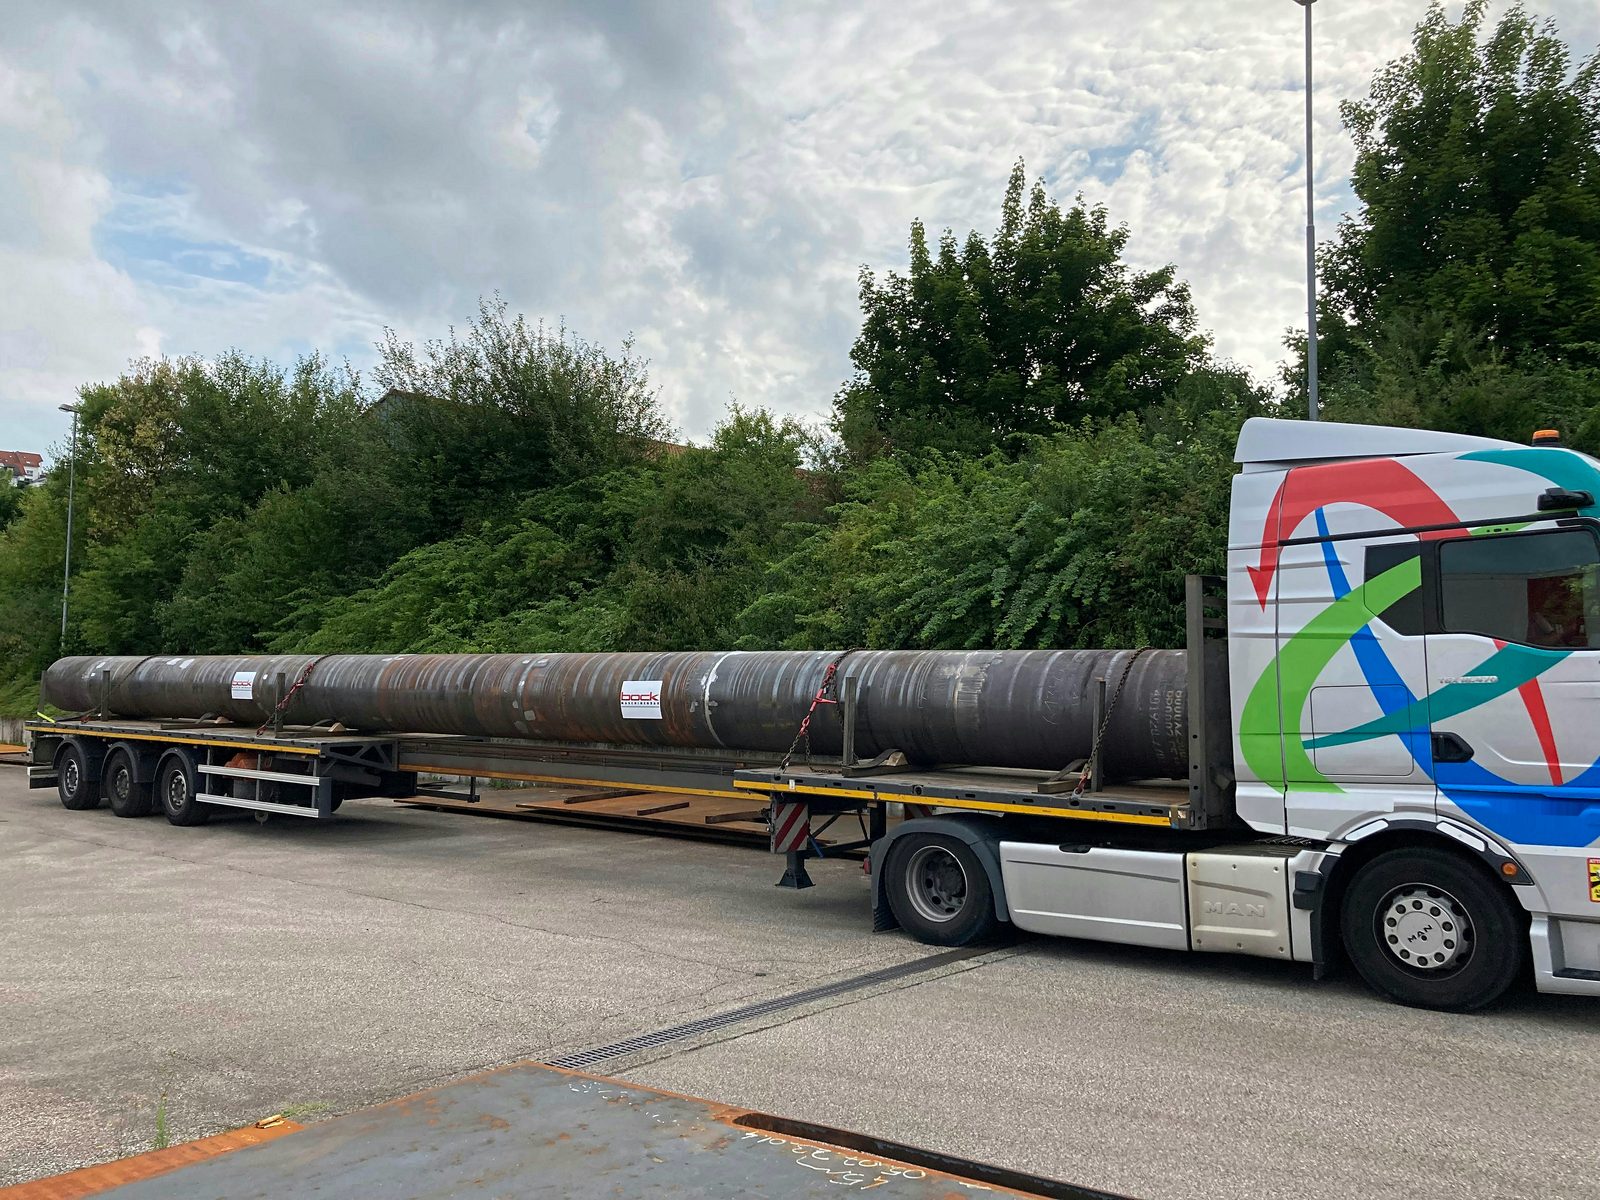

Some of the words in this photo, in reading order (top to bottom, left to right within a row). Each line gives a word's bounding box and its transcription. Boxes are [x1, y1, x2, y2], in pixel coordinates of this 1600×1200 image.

[621, 691, 659, 701] bock
[1203, 901, 1265, 918] MAN
[1407, 924, 1433, 943] MAN
